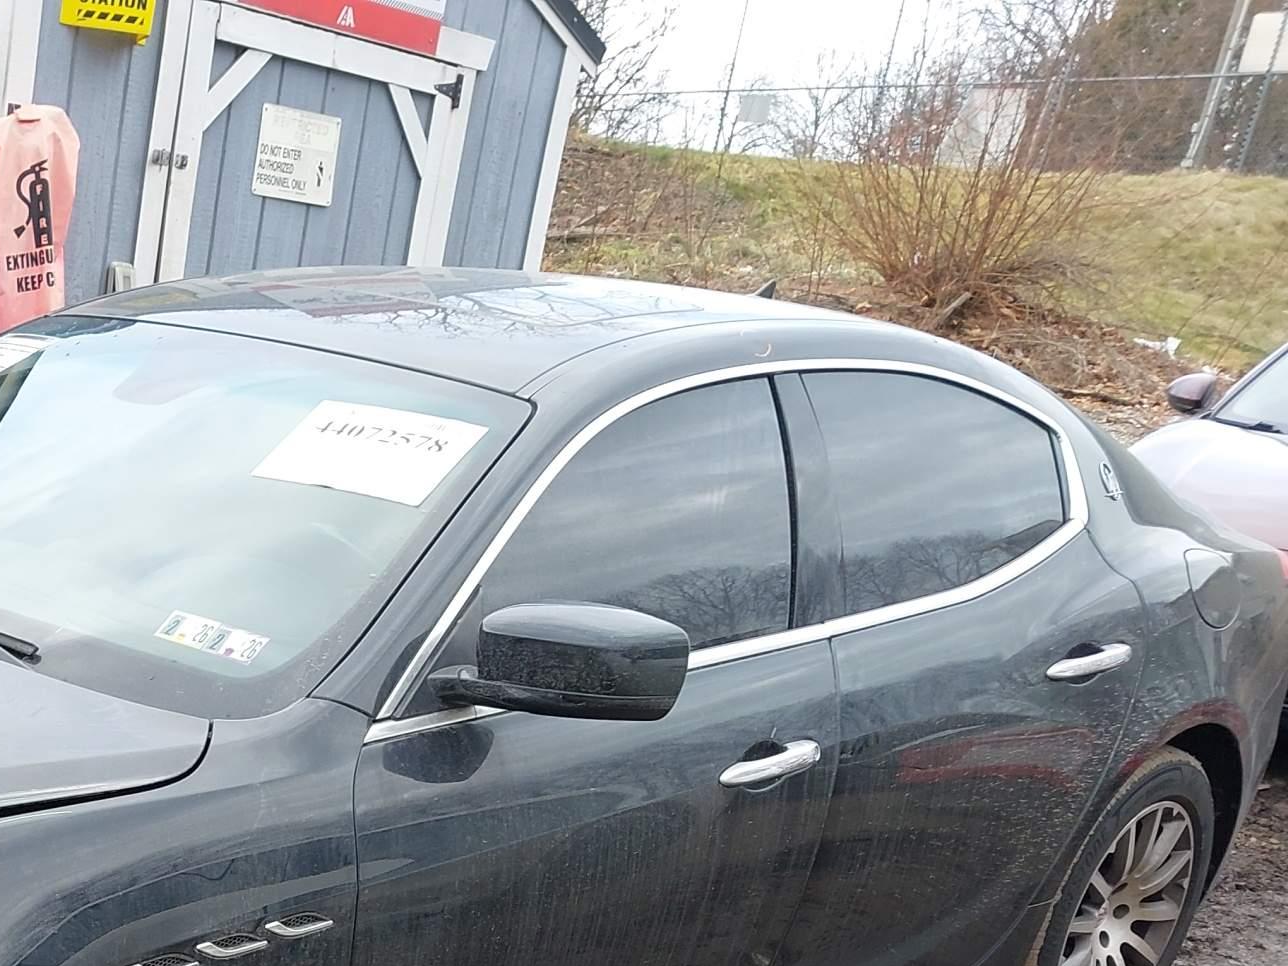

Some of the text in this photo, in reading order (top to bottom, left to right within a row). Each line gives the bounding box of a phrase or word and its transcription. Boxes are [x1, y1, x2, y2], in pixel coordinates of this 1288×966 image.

[259, 143, 302, 160] DO NOT ENTER
[258, 158, 295, 175] AUTHORIZED
[256, 172, 307, 191] PERSONNEL ONLY
[35, 184, 49, 244] FIRE
[17, 274, 43, 294] KEEP
[315, 420, 449, 453] 44072578
